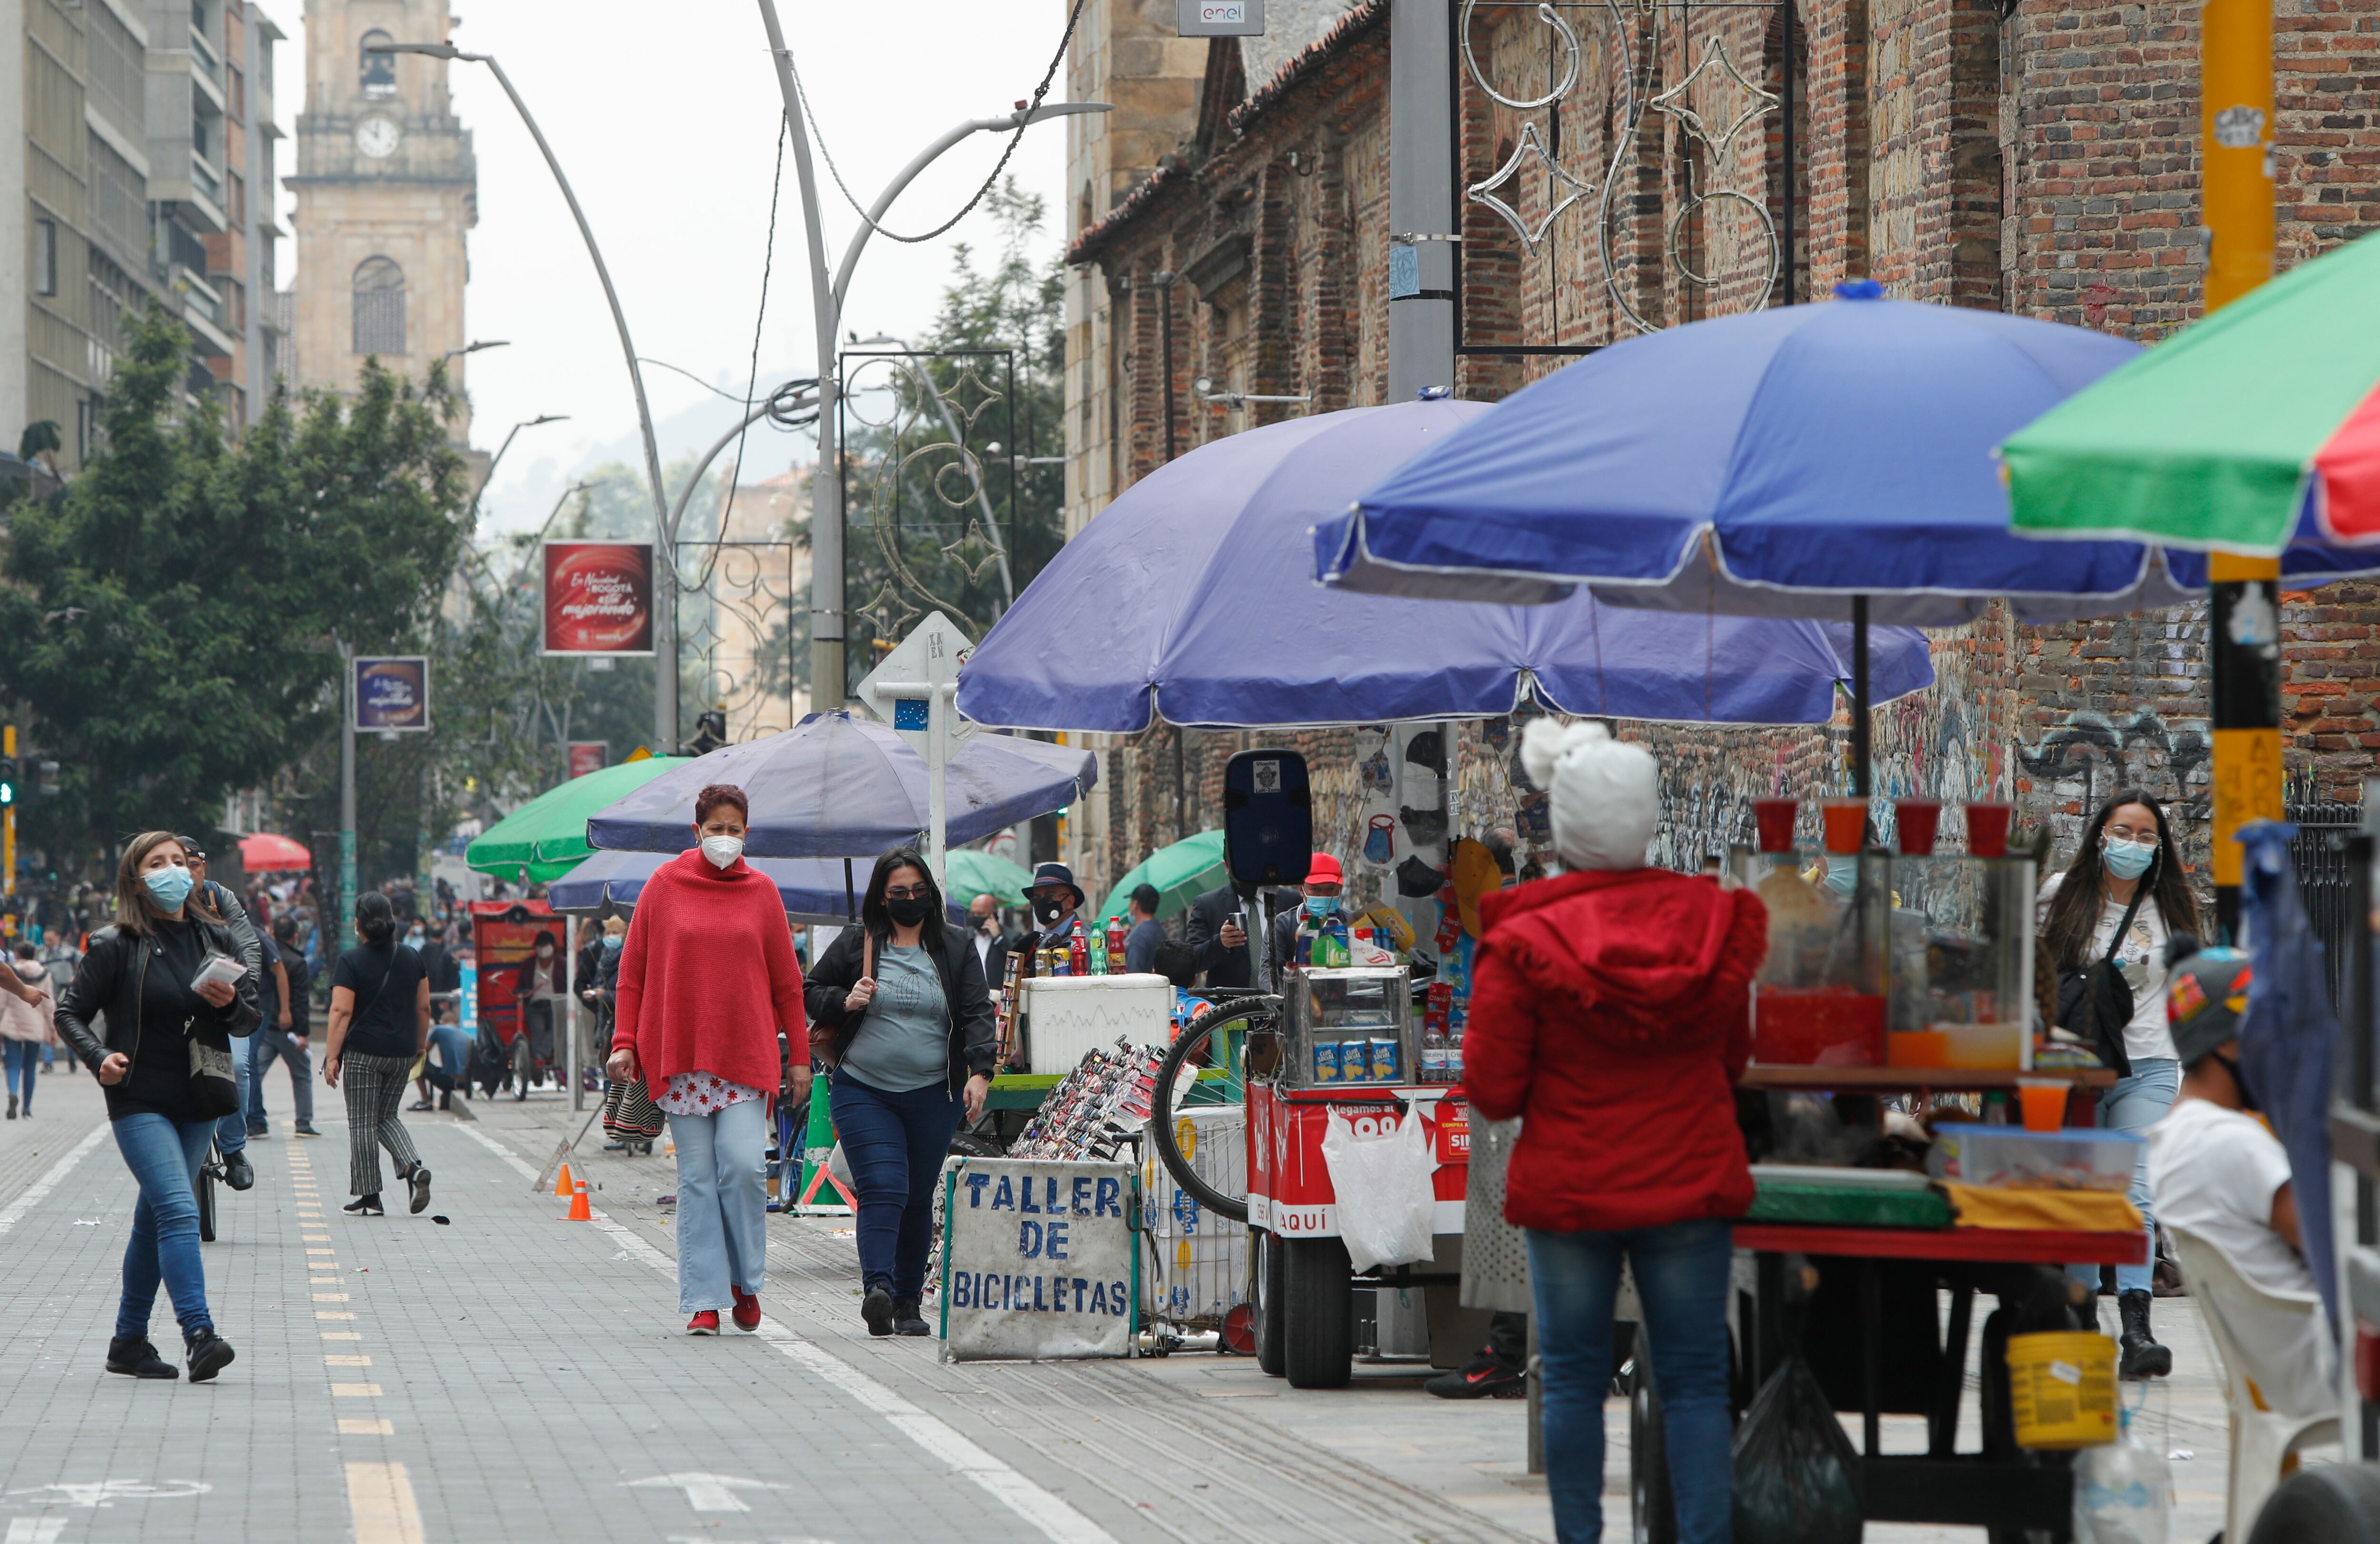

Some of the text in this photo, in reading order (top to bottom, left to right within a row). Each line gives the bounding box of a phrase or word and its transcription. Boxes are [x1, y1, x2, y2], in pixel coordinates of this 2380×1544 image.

[1203, 5, 1241, 20] enel
[965, 1173, 1121, 1218] TALLER
[1019, 1221, 1069, 1260] DE
[953, 1271, 1127, 1317] BICICLETAS
